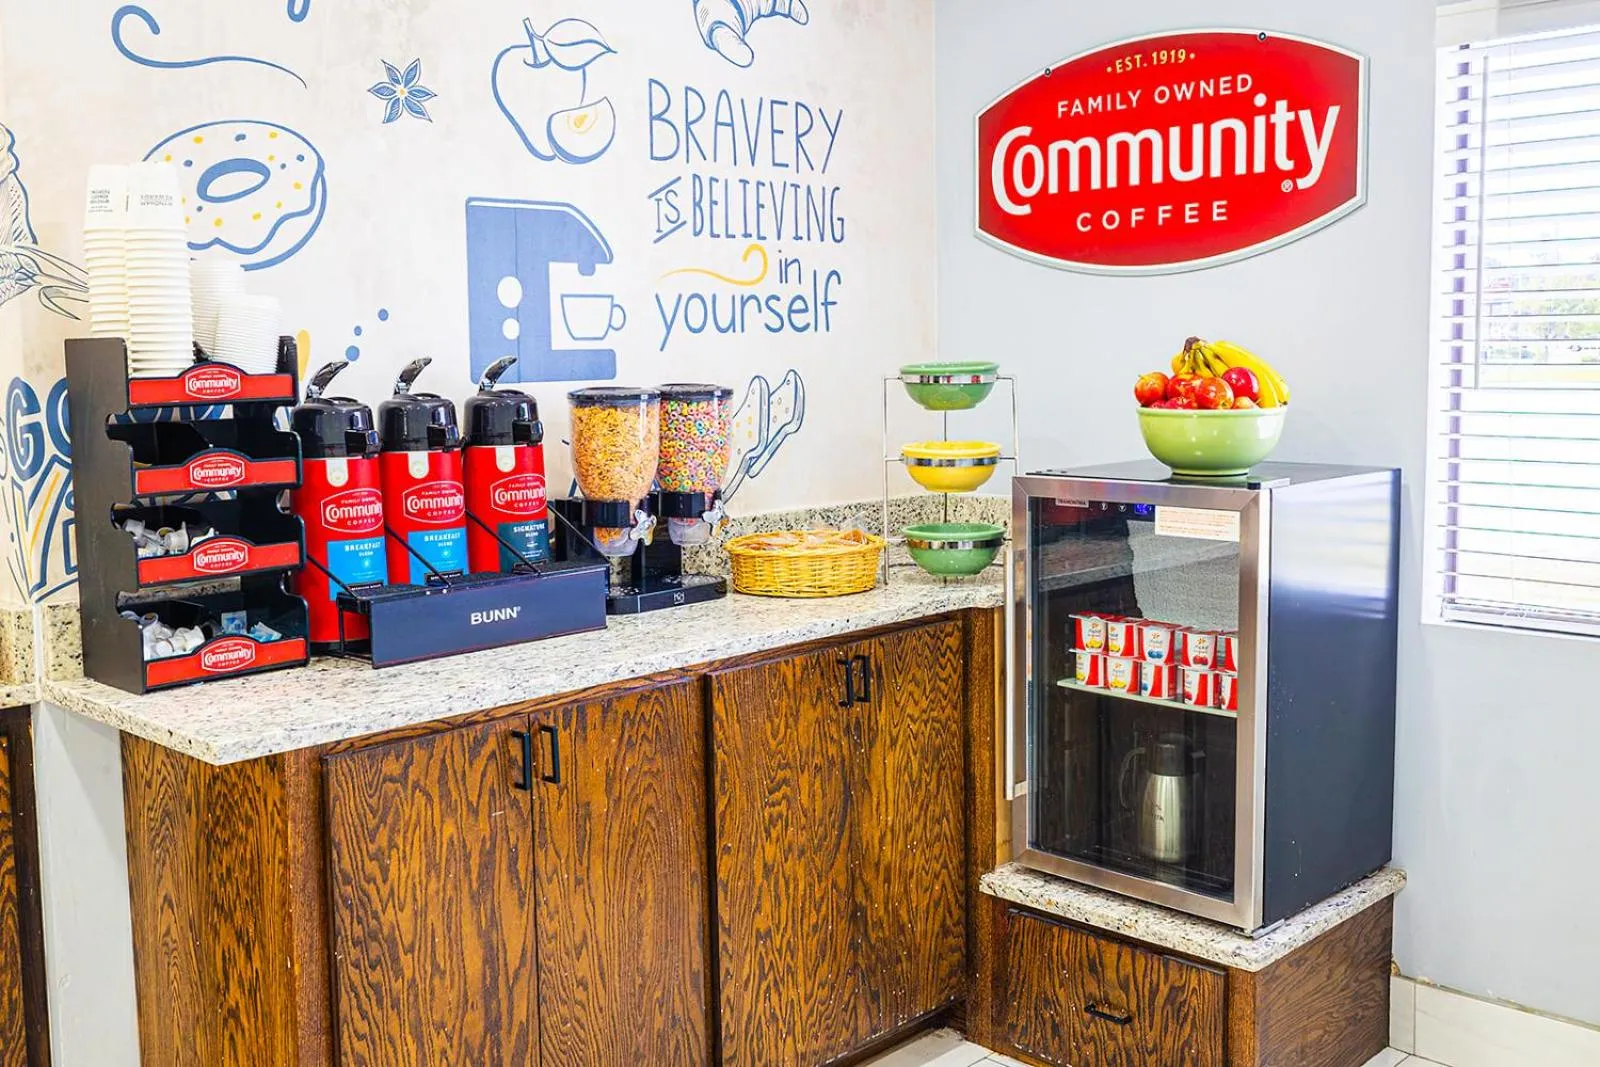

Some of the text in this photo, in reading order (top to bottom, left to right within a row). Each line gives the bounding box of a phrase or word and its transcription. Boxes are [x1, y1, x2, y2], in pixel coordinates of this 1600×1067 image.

[1115, 48, 1187, 73] EST. 1919
[1057, 73, 1253, 118] FAMILY OWNED
[648, 78, 843, 174] BRAVERY
[991, 92, 1341, 215] Community
[655, 173, 845, 243] IS BELIEVING
[1076, 199, 1229, 232] COFFEE
[778, 249, 801, 285] in
[655, 268, 842, 351] yourself
[189, 376, 238, 391] Community
[194, 465, 241, 481] Community
[196, 550, 245, 566] Community
[204, 648, 252, 665] Community
